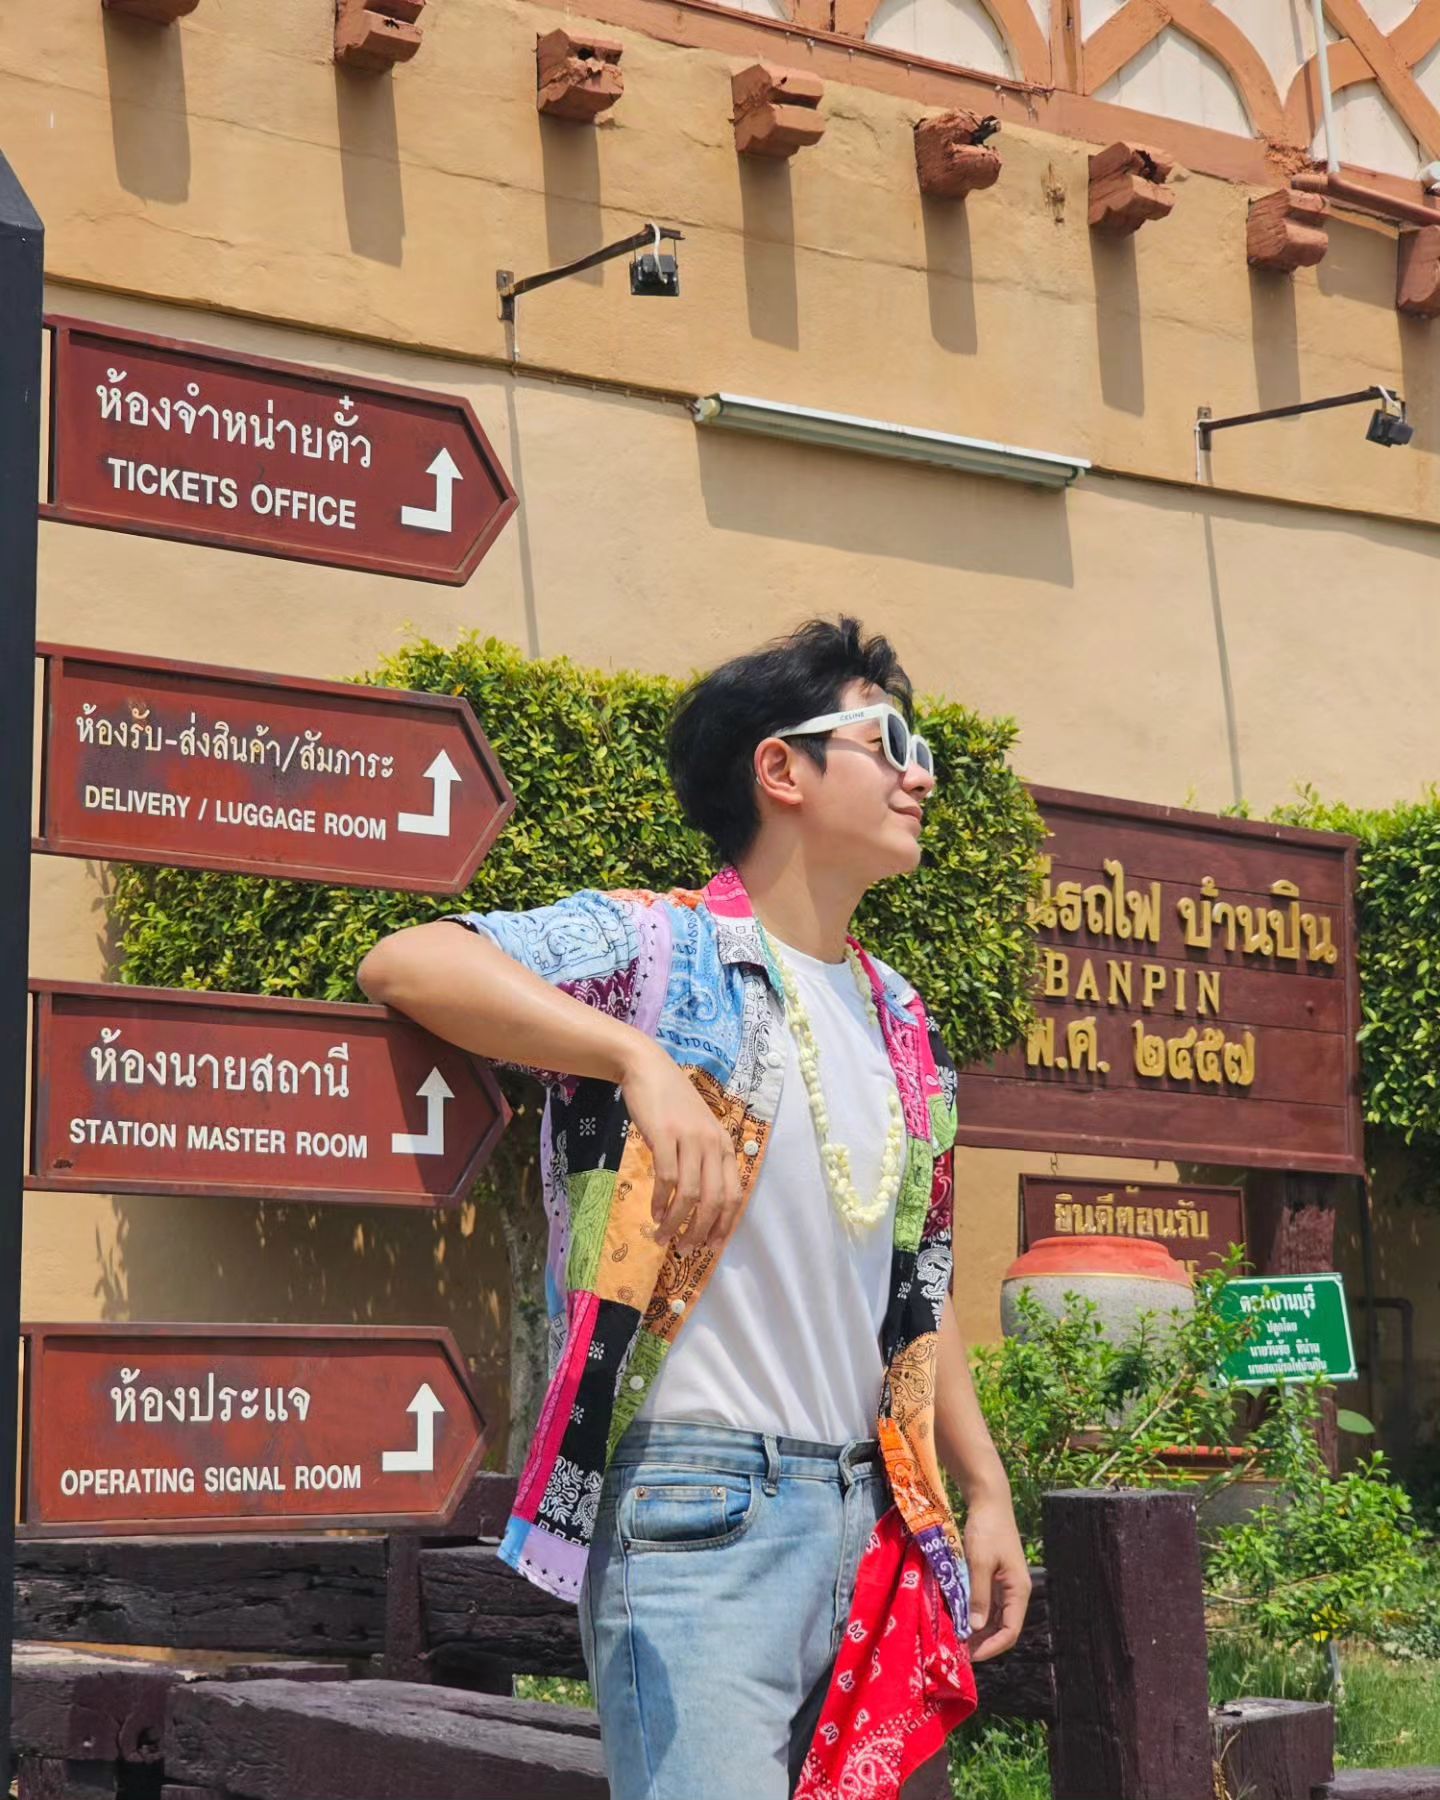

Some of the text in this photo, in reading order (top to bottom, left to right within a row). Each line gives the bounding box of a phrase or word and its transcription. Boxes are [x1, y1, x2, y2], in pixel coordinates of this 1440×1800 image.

[96, 367, 372, 468] ห้องจำหน่ายตั๋ว
[108, 458, 356, 529] TICKETS OFFICE
[77, 704, 393, 778] ห้องรับ-ส่งสินค้า/สัมภาระ
[86, 785, 386, 840] DELIVERY / LUGGAGE ROOM
[1177, 875, 1338, 964] บ้านปิน
[1044, 951, 1220, 1014] BANPIN
[91, 1028, 349, 1097] ห้องนายสถานี
[1132, 1019, 1256, 1086] ๒๔๕๗
[70, 1118, 367, 1158] STATION MASTER ROOM
[1055, 1185, 1209, 1239] ยินดีต้อนรับ
[111, 1368, 310, 1422] ห้องประแจ
[61, 1465, 360, 1495] OPERATING SIGNAL ROOM
